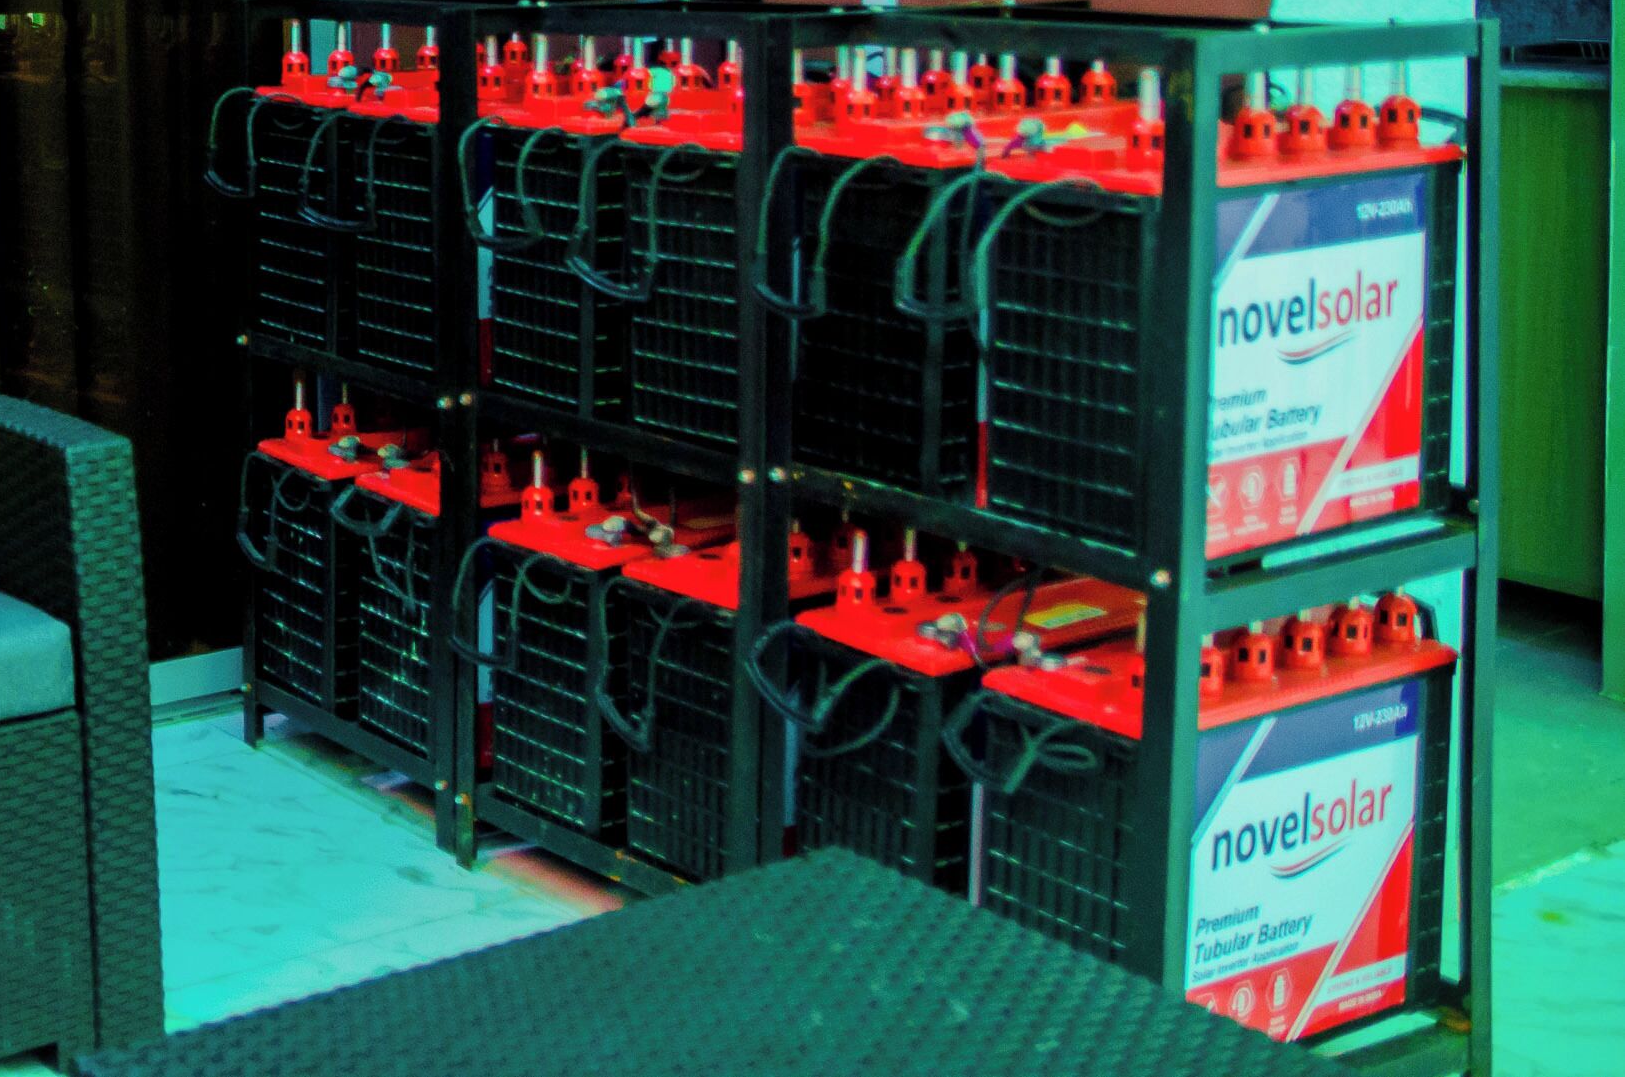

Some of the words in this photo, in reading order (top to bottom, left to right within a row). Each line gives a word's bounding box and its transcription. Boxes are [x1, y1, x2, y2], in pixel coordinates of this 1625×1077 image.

[1217, 269, 1399, 348] novelsolar
[1209, 414, 1262, 440] ubular
[1267, 404, 1321, 430] Battery
[1211, 778, 1394, 871] novelsolar
[1195, 905, 1259, 937] Premium
[1195, 932, 1253, 964] Tubular
[1258, 914, 1314, 944] Battery
